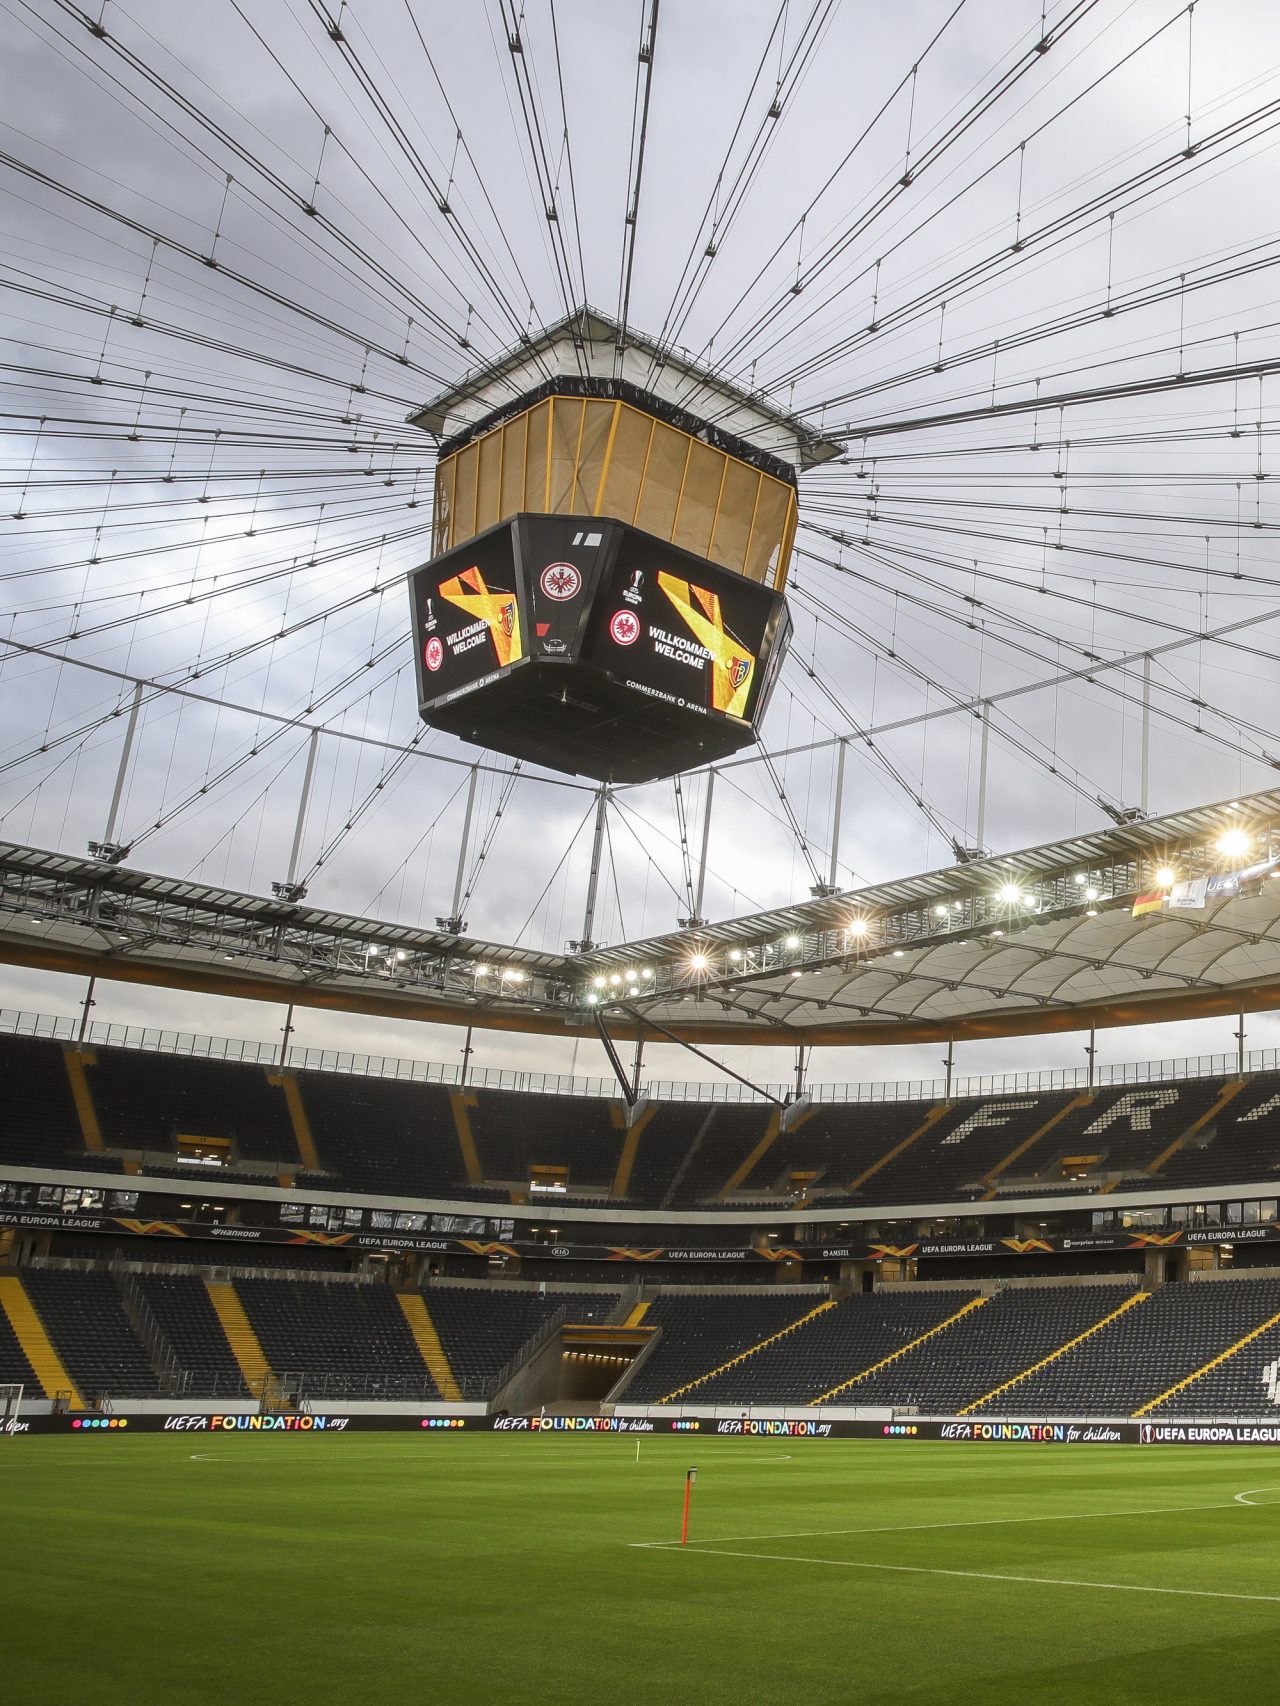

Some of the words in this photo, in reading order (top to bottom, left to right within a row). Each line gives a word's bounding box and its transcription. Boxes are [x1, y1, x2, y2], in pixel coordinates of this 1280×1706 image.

[446, 619, 490, 646] WILLKOMMEN
[453, 632, 486, 655] WELCOME
[649, 626, 717, 661] WILLKOMMEN
[655, 642, 705, 670] WELCOME
[626, 680, 676, 703] COMMERZBANK
[686, 702, 707, 715] ARENA
[20, 1216, 59, 1226] EUROPA
[62, 1219, 100, 1228] LEAGUE
[359, 1237, 380, 1245] UEFA
[382, 1239, 414, 1248] EUROPA
[1188, 1232, 1206, 1241] UEFA
[1208, 1231, 1236, 1240] EUROPA
[922, 1245, 939, 1253] UEFA
[940, 1244, 966, 1252] EUROPA
[164, 1415, 208, 1431] UEFA
[494, 1417, 529, 1430] UEFA
[531, 1417, 618, 1431] FOUNDATION
[618, 1418, 629, 1432] for
[629, 1418, 654, 1432] children
[717, 1420, 743, 1434] UEFA
[941, 1424, 971, 1438] UEFA
[974, 1425, 1064, 1441] FOUNDATION
[1066, 1427, 1080, 1444] for
[1082, 1427, 1121, 1441] children
[1155, 1427, 1186, 1440] UEFA
[1189, 1427, 1234, 1441] EUROPA
